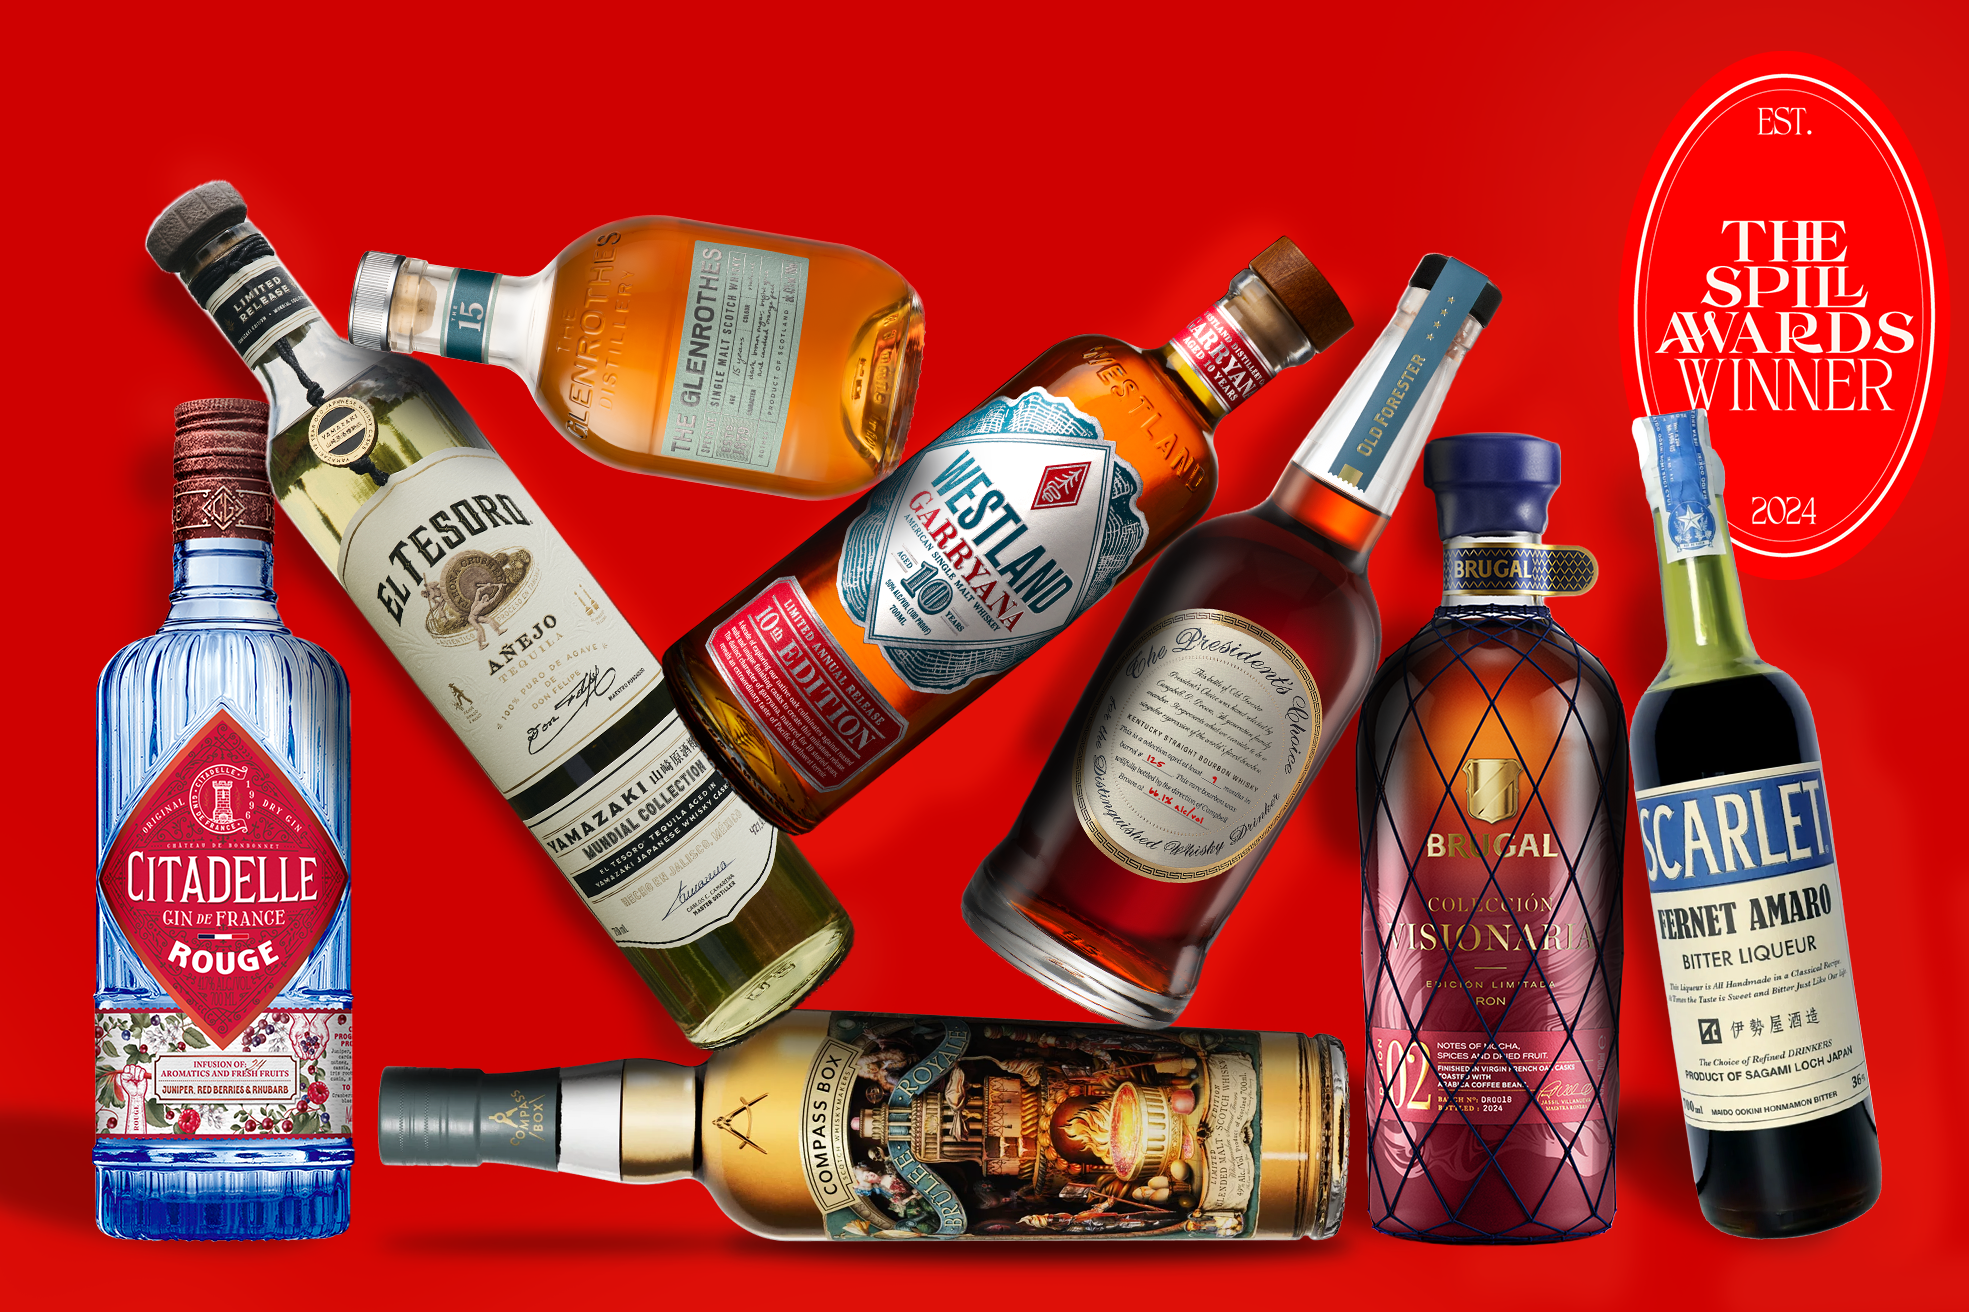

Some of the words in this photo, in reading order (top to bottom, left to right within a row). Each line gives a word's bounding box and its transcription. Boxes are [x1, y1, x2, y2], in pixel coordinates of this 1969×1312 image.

[729, 257, 742, 291] WHISKY
[233, 276, 281, 312] LIMITED
[239, 284, 290, 323] RELEASE
[458, 301, 483, 332] 15
[556, 307, 578, 352] THE
[680, 248, 723, 407] GLENROTHES
[723, 295, 736, 334] SCOTCH
[778, 309, 789, 355] SCOTLAND
[566, 231, 621, 440] GLENROTHES
[599, 271, 634, 411] DISTILLERY
[718, 340, 730, 368] MALT
[776, 361, 782, 371] OF
[1183, 336, 1205, 360] AGED
[1203, 359, 1215, 373] 10
[1212, 371, 1238, 401] YEARS
[713, 370, 725, 406] SINGLE
[768, 376, 779, 415] PRODUCT
[1357, 427, 1383, 457] OLD
[1374, 354, 1426, 427] FORESTER
[671, 413, 696, 452] THE
[1082, 347, 1204, 492] WESTLAND
[389, 494, 530, 586] TESORO
[931, 449, 1073, 613] WESTLAND
[897, 551, 913, 569] AGED
[904, 513, 934, 551] AMERICAN
[930, 550, 957, 580] SINGLE
[953, 579, 975, 603] MALT
[971, 599, 1000, 633] WHISKEY
[909, 490, 1024, 632] GARRYANA
[1454, 560, 1532, 579] BRUGAL
[377, 575, 411, 627] EL
[901, 561, 953, 615] 10
[889, 604, 907, 626] 700ML
[945, 611, 965, 632] YEARS
[489, 614, 557, 676] AÑEJO
[498, 632, 563, 684] TEQUILA
[784, 599, 816, 641] LIMITED
[812, 643, 845, 686] ANNUAL
[846, 685, 885, 727] RELEASE
[501, 697, 520, 720] 100%
[521, 671, 545, 695] PURO
[549, 659, 562, 671] DE
[566, 643, 598, 660] AGAVE
[532, 693, 551, 710] DON
[553, 669, 582, 695] FELIPE
[545, 676, 557, 688] DE
[756, 606, 784, 643] 10th
[777, 640, 875, 750] EDITION
[1125, 645, 1167, 679] The
[1172, 627, 1293, 696] President's
[1284, 696, 1310, 775] Choice
[1125, 712, 1163, 737] KENTUCKY
[1162, 734, 1197, 757] STRAIGHT
[1197, 754, 1231, 777] BOURBON
[1231, 773, 1259, 793] WHISKY
[1146, 755, 1166, 768] 125
[195, 767, 236, 787] CITADELLE
[1096, 725, 1108, 749] the
[1164, 840, 1225, 858] Whisky
[1229, 792, 1281, 846] Drinker
[142, 798, 186, 834] ORIGINAL
[262, 799, 282, 815] DRY
[285, 815, 302, 832] GIN
[547, 780, 649, 854] YAMAZAKI
[582, 818, 640, 860] MUNDIAL
[638, 759, 707, 823] COLLECTION
[1149, 787, 1173, 805] 66.1%
[1174, 803, 1204, 824] alc/vol
[595, 859, 635, 888] YAMAZAKI
[637, 827, 680, 864] JAPANESE
[681, 799, 712, 828] WHISKY
[599, 866, 610, 875] EL
[611, 843, 643, 868] TESORO
[649, 809, 687, 841] TEQUILA
[688, 791, 708, 810] AGED
[709, 782, 717, 790] IN
[1427, 833, 1559, 858] BRUGAL
[1639, 778, 1825, 882] SCARLET
[127, 850, 318, 903] CITADELLE
[163, 910, 193, 926] GIN
[197, 914, 212, 925] DE
[216, 909, 285, 926] FRANCE
[1428, 893, 1553, 912] COLECCIÓN
[1658, 901, 1737, 940] FERNET
[1749, 883, 1832, 931] AMARO
[1387, 922, 1595, 951] VISIONARIA
[1682, 950, 1733, 970] BITTER
[1739, 935, 1817, 965] LIQUEUR
[168, 940, 279, 974] ROUGE
[1713, 982, 1724, 990] All
[1726, 976, 1771, 989] Handmade
[1791, 964, 1822, 977] Classical
[1476, 997, 1506, 1005] RON
[1730, 1007, 1820, 1039] 伊勢屋酒造
[897, 1029, 968, 1098] ROYALE
[1685, 1069, 1724, 1082] PRODUCT
[1727, 1071, 1742, 1082] OF
[1745, 1064, 1792, 1081] SAGAMI
[1795, 1056, 1825, 1072] LOCH
[1827, 1045, 1853, 1064] JAPAN
[1699, 1058, 1711, 1067] The
[1713, 1058, 1739, 1067] Choice
[1742, 1056, 1752, 1066] of
[1752, 1051, 1786, 1065] Refined
[1788, 1039, 1833, 1058] DRINKERS
[198, 1086, 212, 1094] RED
[214, 1086, 244, 1094] BERRIES
[246, 1086, 251, 1094] &
[253, 1086, 289, 1094] RHUBARB
[817, 1054, 842, 1093] BOX
[1219, 1060, 1230, 1092] WHISKY
[1387, 1040, 1431, 1109] 02
[510, 1089, 530, 1146] COMPASS
[533, 1102, 544, 1132] BOX
[835, 1071, 850, 1142] WHISKYMAKERS
[1217, 1095, 1229, 1131] SCOTCH
[1712, 1108, 1733, 1116] MAIDO
[1735, 1107, 1762, 1115] OOKINI
[1764, 1098, 1812, 1113] HONMAMON
[1814, 1090, 1837, 1104] BITTER
[812, 1099, 838, 1195] COMPASS
[835, 1146, 848, 1181] SCOTCH
[1218, 1137, 1226, 1164] MALT
